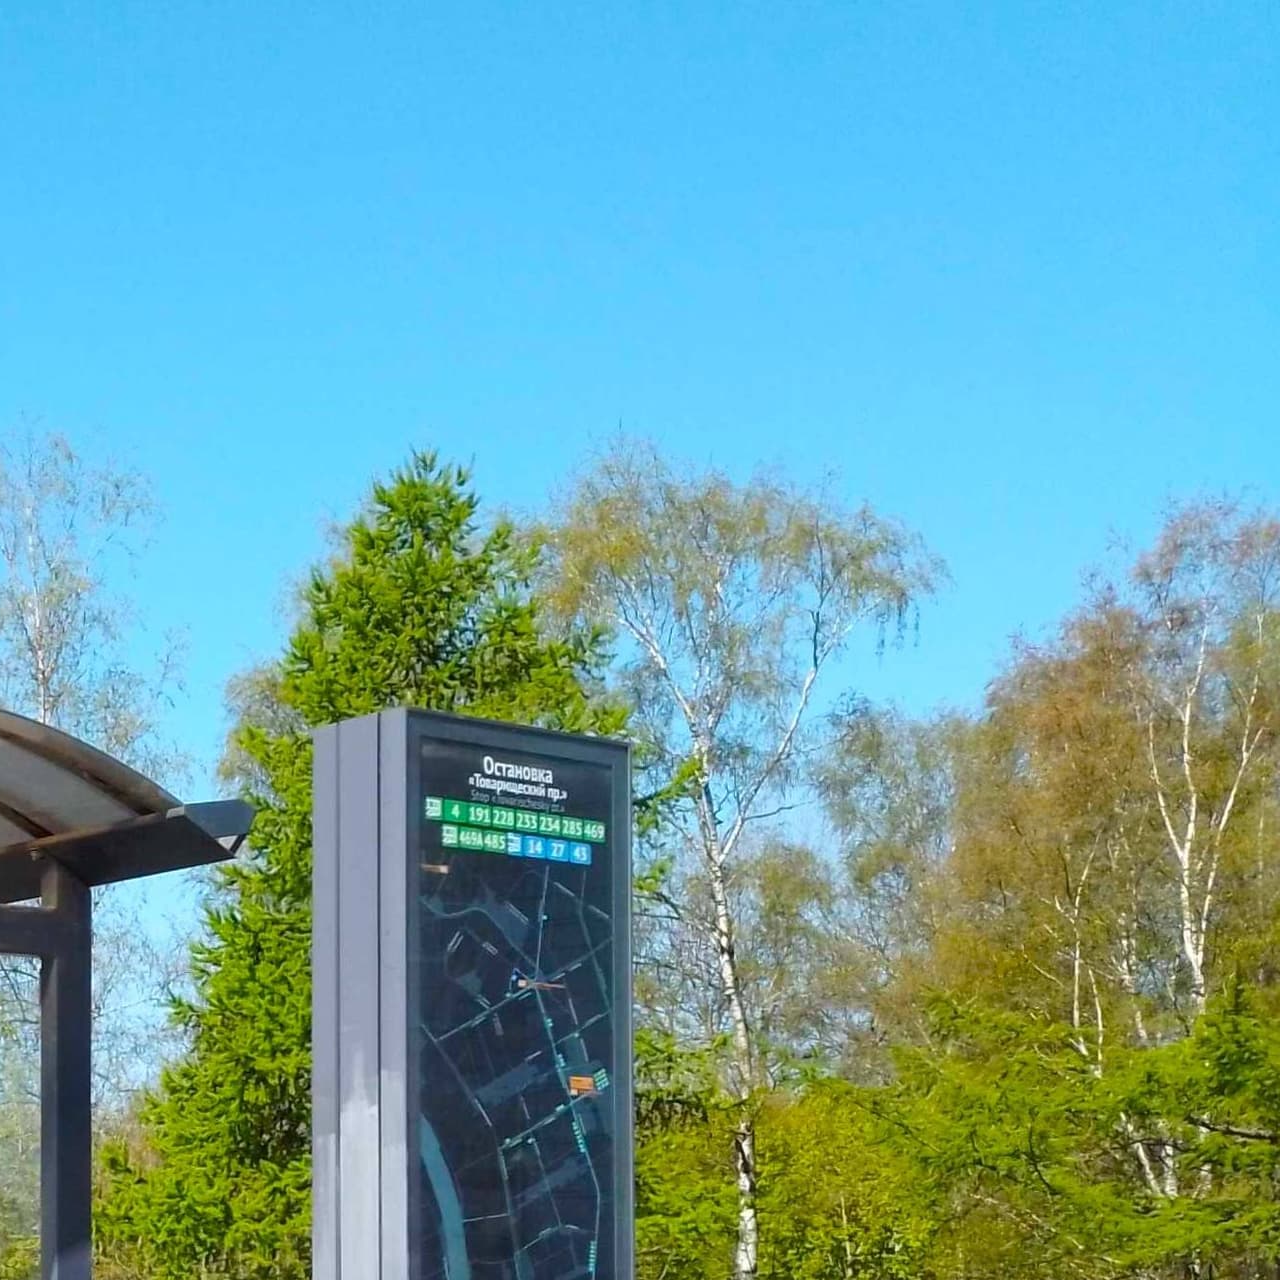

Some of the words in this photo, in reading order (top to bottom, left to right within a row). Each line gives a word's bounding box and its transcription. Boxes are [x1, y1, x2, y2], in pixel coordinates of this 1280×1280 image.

[483, 756, 553, 784] Остановка
[451, 804, 460, 818] 4
[469, 806, 490, 823] 191
[493, 810, 514, 826] 228
[539, 816, 560, 833] 234
[562, 819, 582, 836] 285
[584, 822, 605, 839] 469
[484, 833, 505, 850] 485
[528, 839, 543, 853] 14
[551, 842, 565, 857] 27
